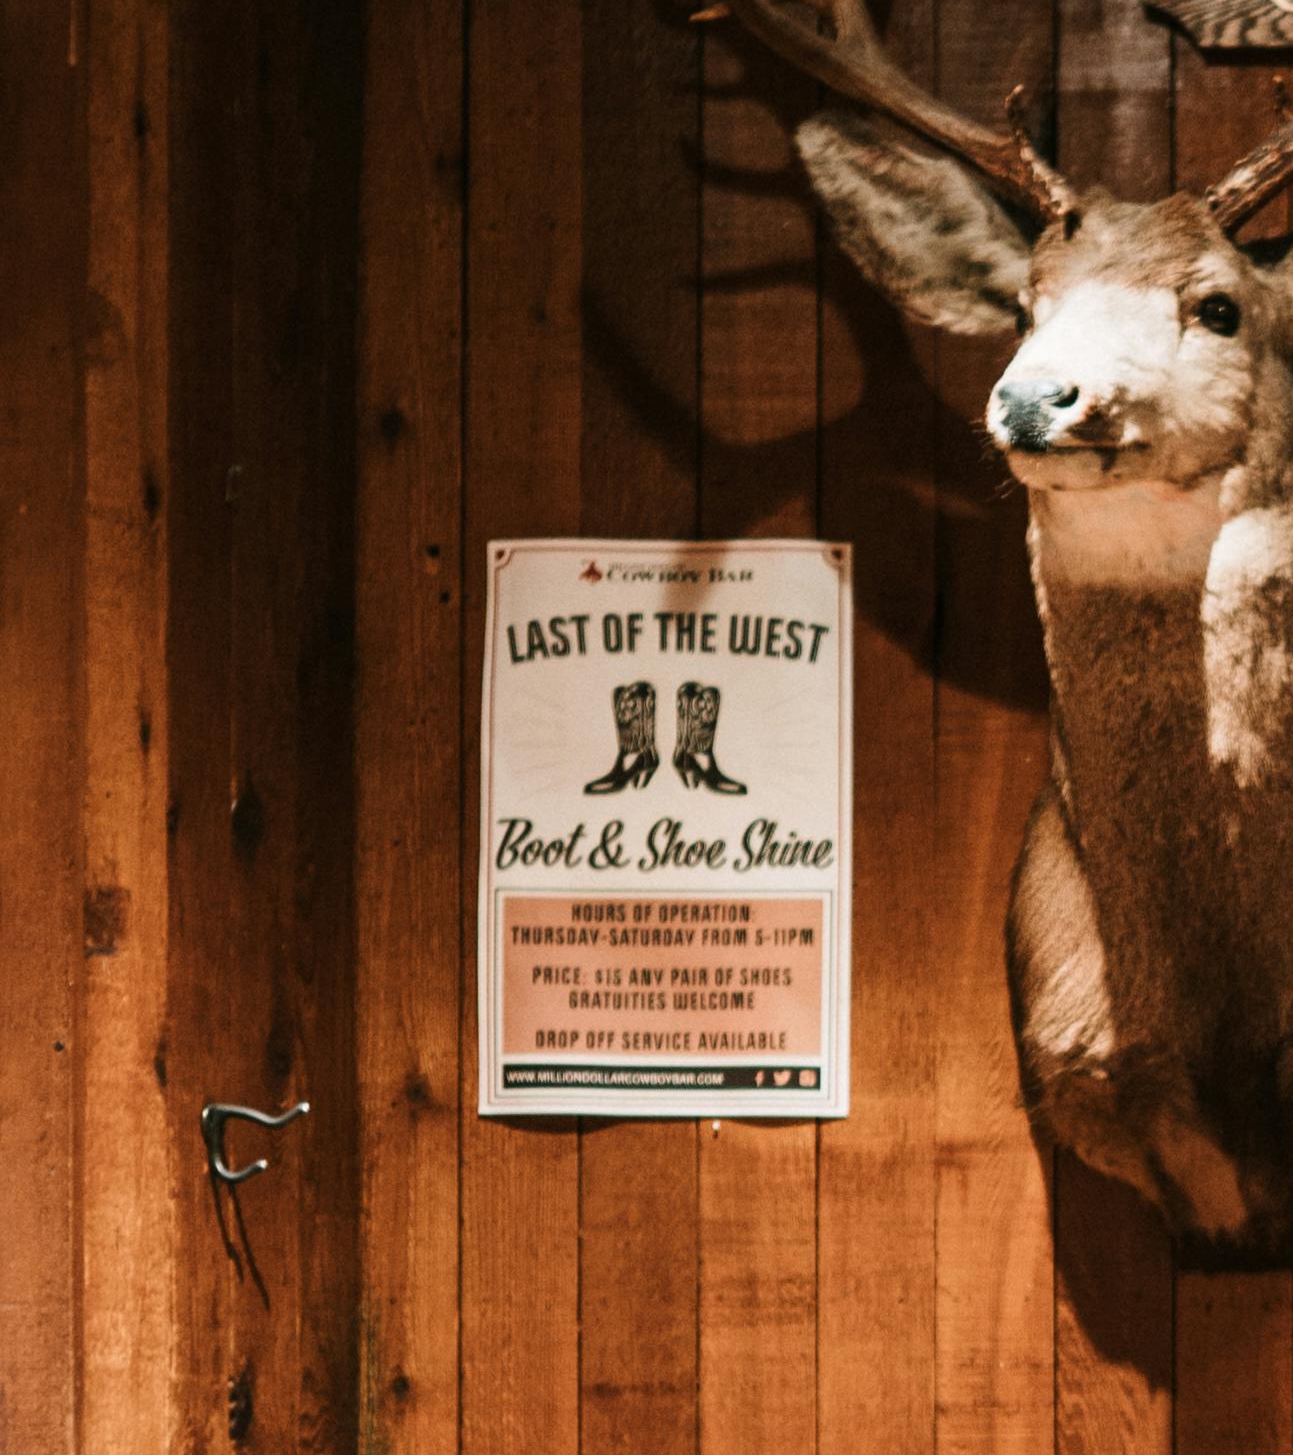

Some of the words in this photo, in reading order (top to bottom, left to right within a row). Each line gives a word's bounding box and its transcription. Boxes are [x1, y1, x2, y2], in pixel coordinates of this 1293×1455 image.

[506, 614, 590, 664] LAST
[602, 612, 644, 654] OF
[653, 611, 718, 654] THE
[728, 613, 830, 664] WEST
[495, 817, 586, 870] Boot
[588, 819, 631, 870] &
[638, 816, 728, 873] Shoe
[733, 817, 835, 873] Shine
[571, 903, 626, 923] HOURS
[633, 903, 652, 923] OF
[511, 925, 695, 947] THURSDAY-SATURDAY
[702, 927, 748, 947] FROM
[629, 967, 664, 986] ANY
[670, 967, 708, 987] PAIR
[714, 967, 733, 987] OF
[739, 967, 792, 987] SHOES
[568, 990, 666, 1011] GRATUITIES
[672, 991, 755, 1011] WELCOME
[535, 1029, 580, 1049] DROP
[586, 1030, 615, 1050] OFF
[621, 1031, 691, 1051] SERVICE
[697, 1031, 787, 1051] AVAILABLE
